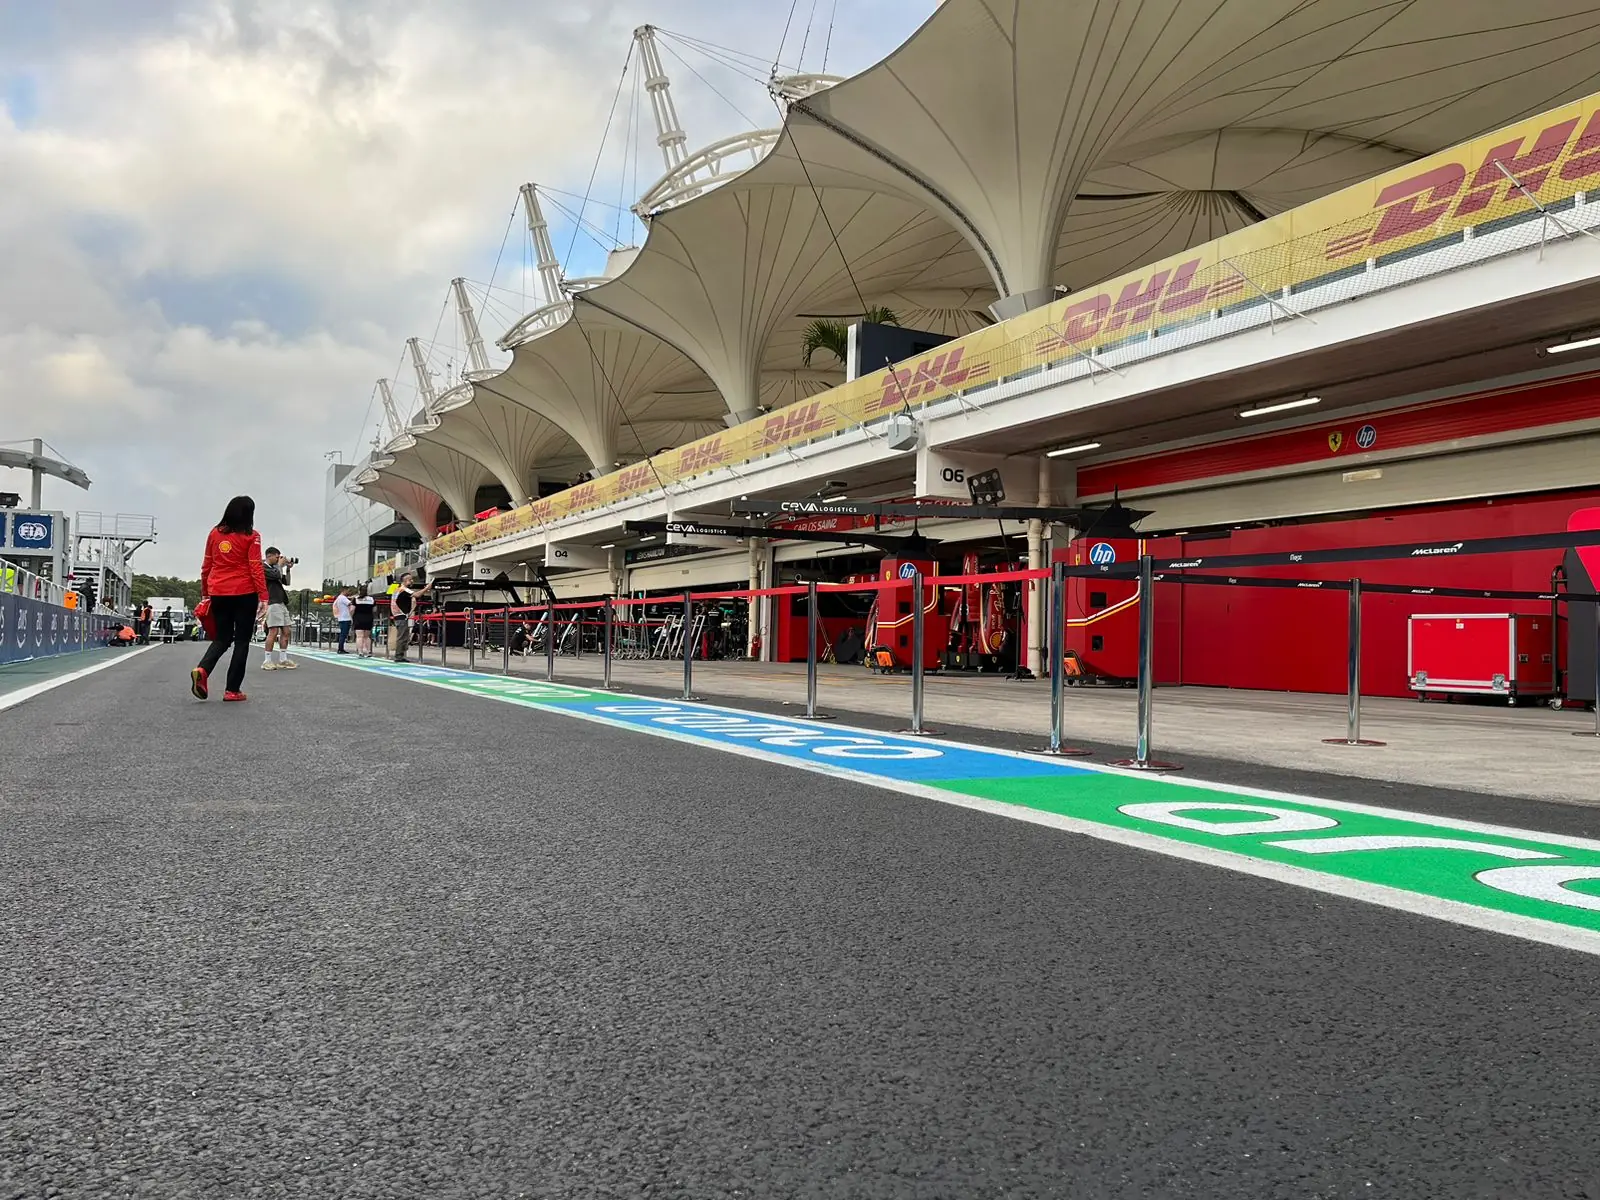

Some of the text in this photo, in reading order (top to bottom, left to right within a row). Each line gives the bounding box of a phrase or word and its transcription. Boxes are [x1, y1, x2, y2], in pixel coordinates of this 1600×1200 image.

[1061, 259, 1209, 346] DHL
[880, 347, 971, 408] DHL
[763, 402, 823, 447] DHL
[1358, 425, 1376, 448] hp
[680, 438, 723, 473] DHL
[618, 465, 656, 494] DHL
[943, 468, 964, 482] 06
[20, 525, 45, 537] FIA
[555, 550, 568, 558] 04
[1093, 543, 1113, 565] hp
[1411, 545, 1459, 555] McLaren
[480, 567, 491, 575] 03
[900, 562, 916, 580] hp
[595, 704, 945, 759] aramco
